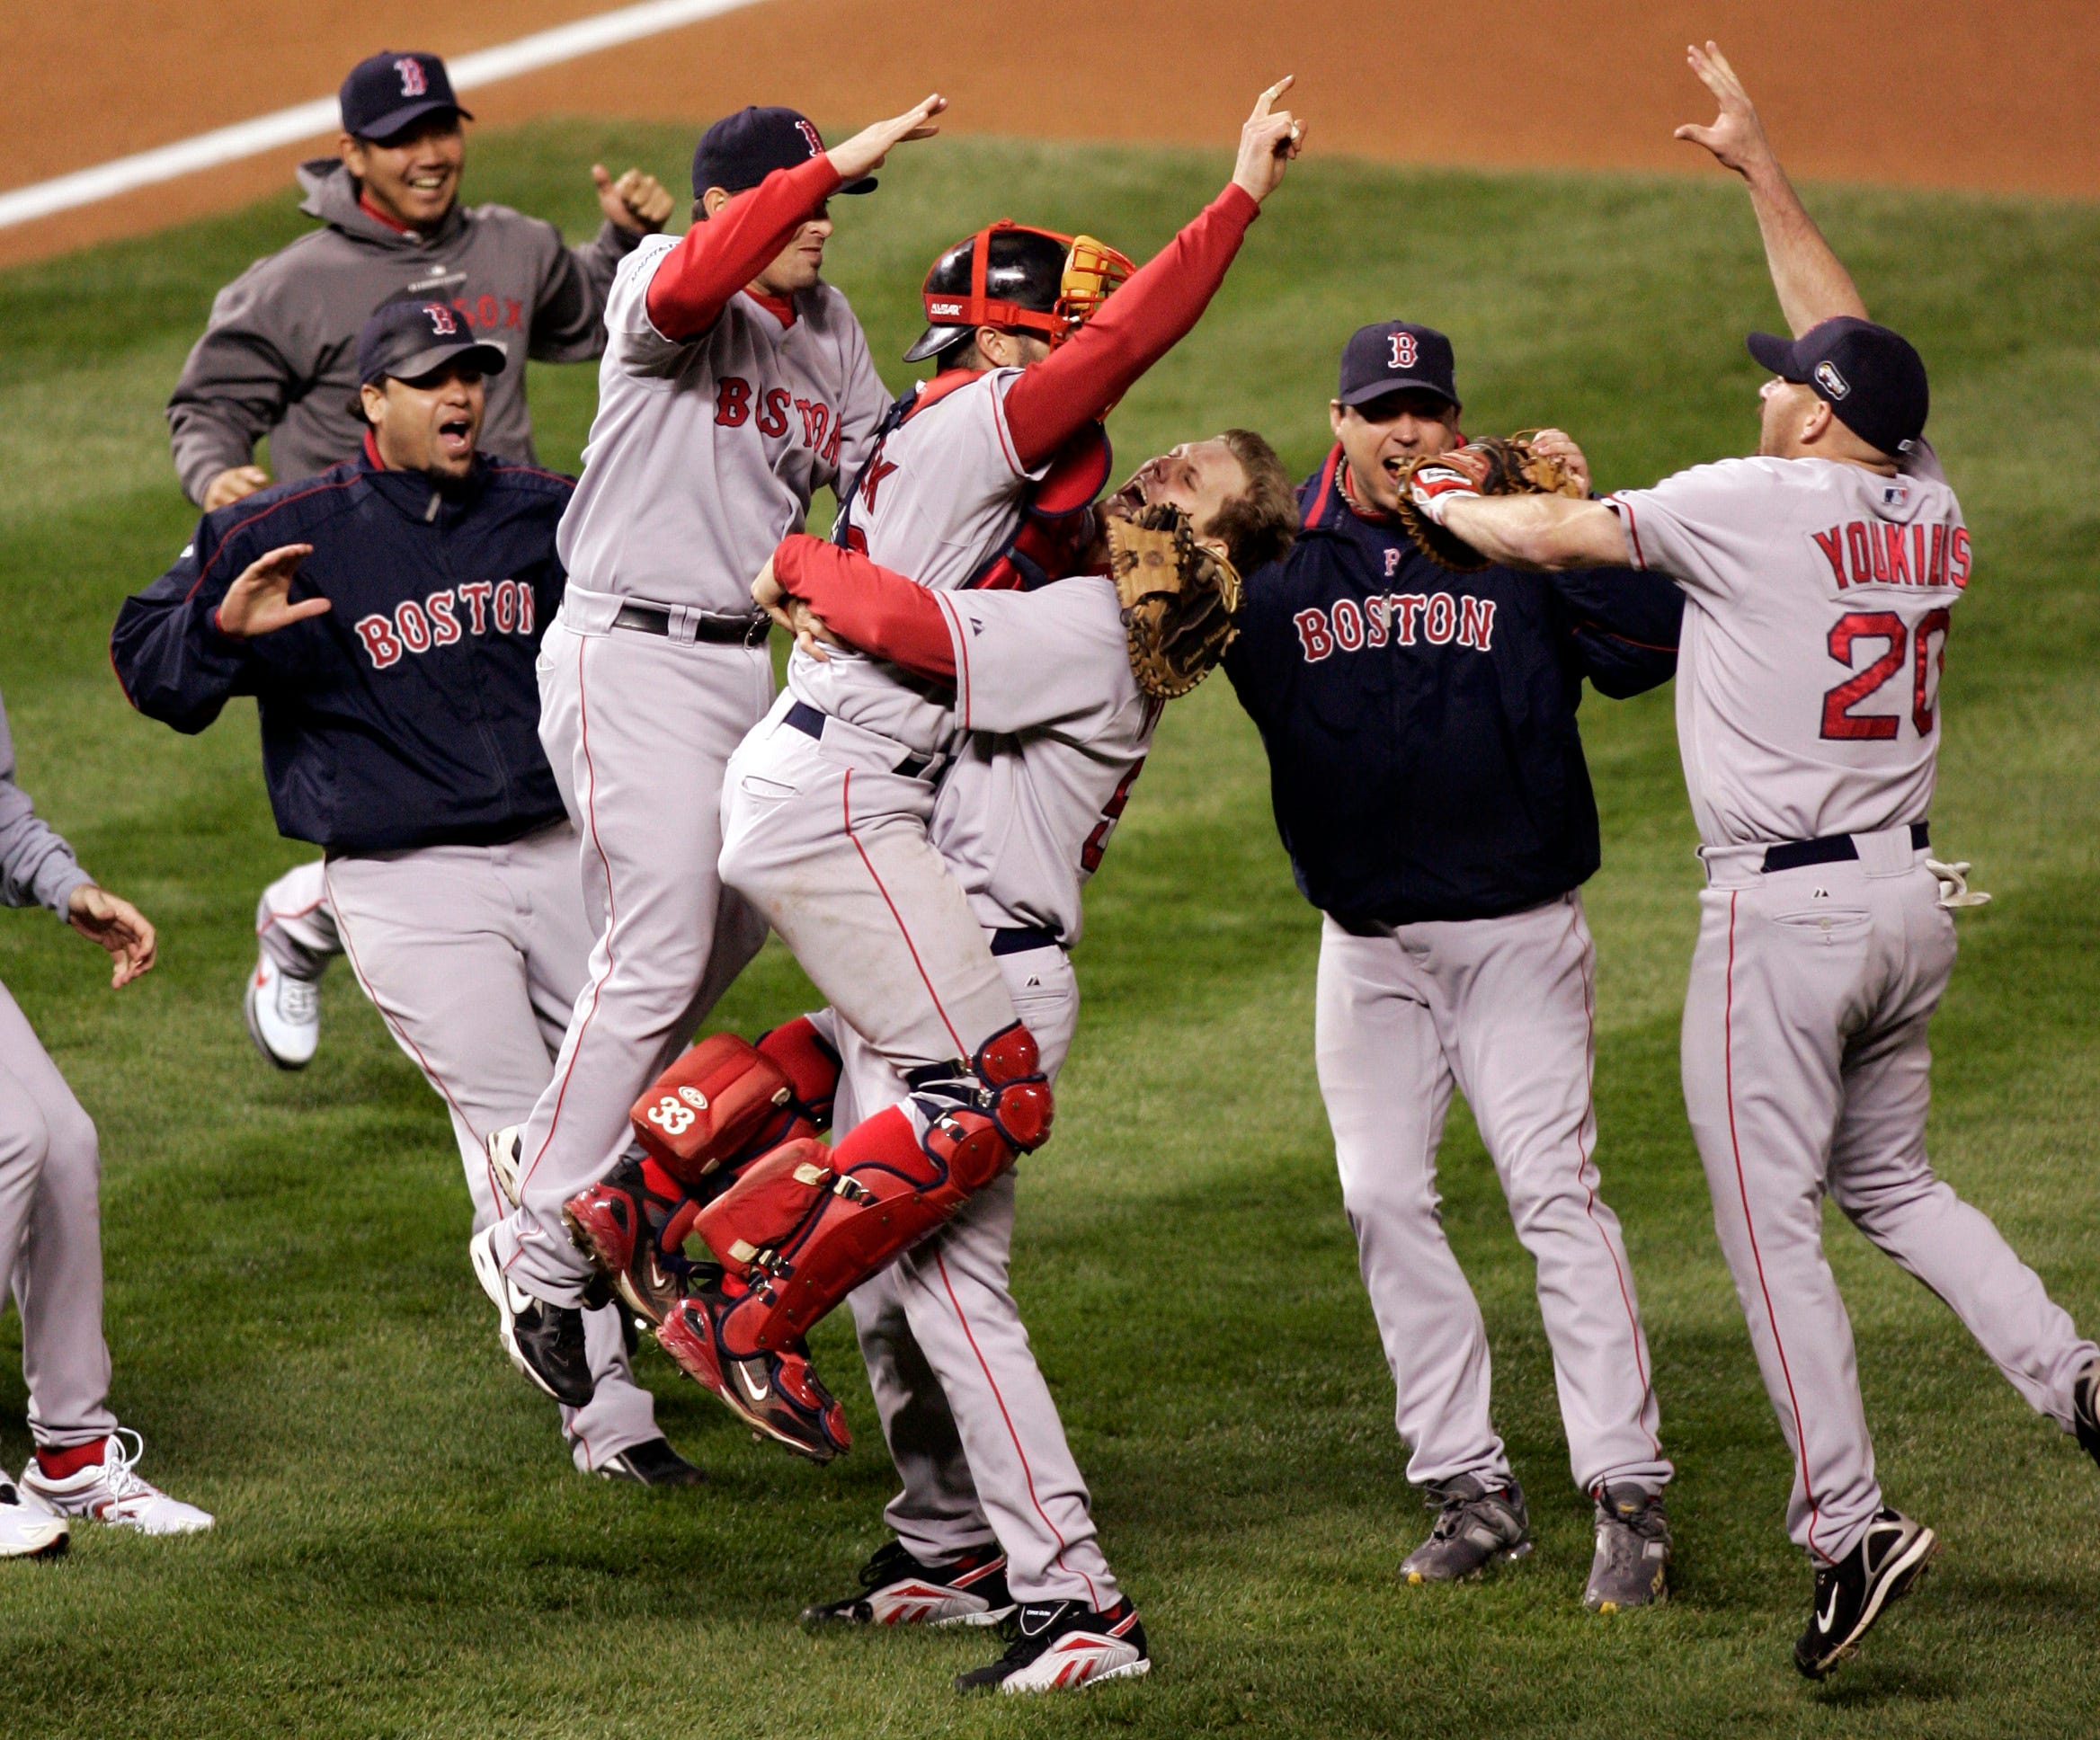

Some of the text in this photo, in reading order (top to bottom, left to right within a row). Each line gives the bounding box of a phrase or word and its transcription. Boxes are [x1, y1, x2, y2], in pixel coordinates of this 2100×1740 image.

[394, 58, 428, 96] B
[423, 302, 457, 335] B
[1387, 332, 1418, 368] B
[1294, 591, 1497, 662] BOSTON
[1820, 606, 1951, 741] 20
[647, 1096, 696, 1135] 33
